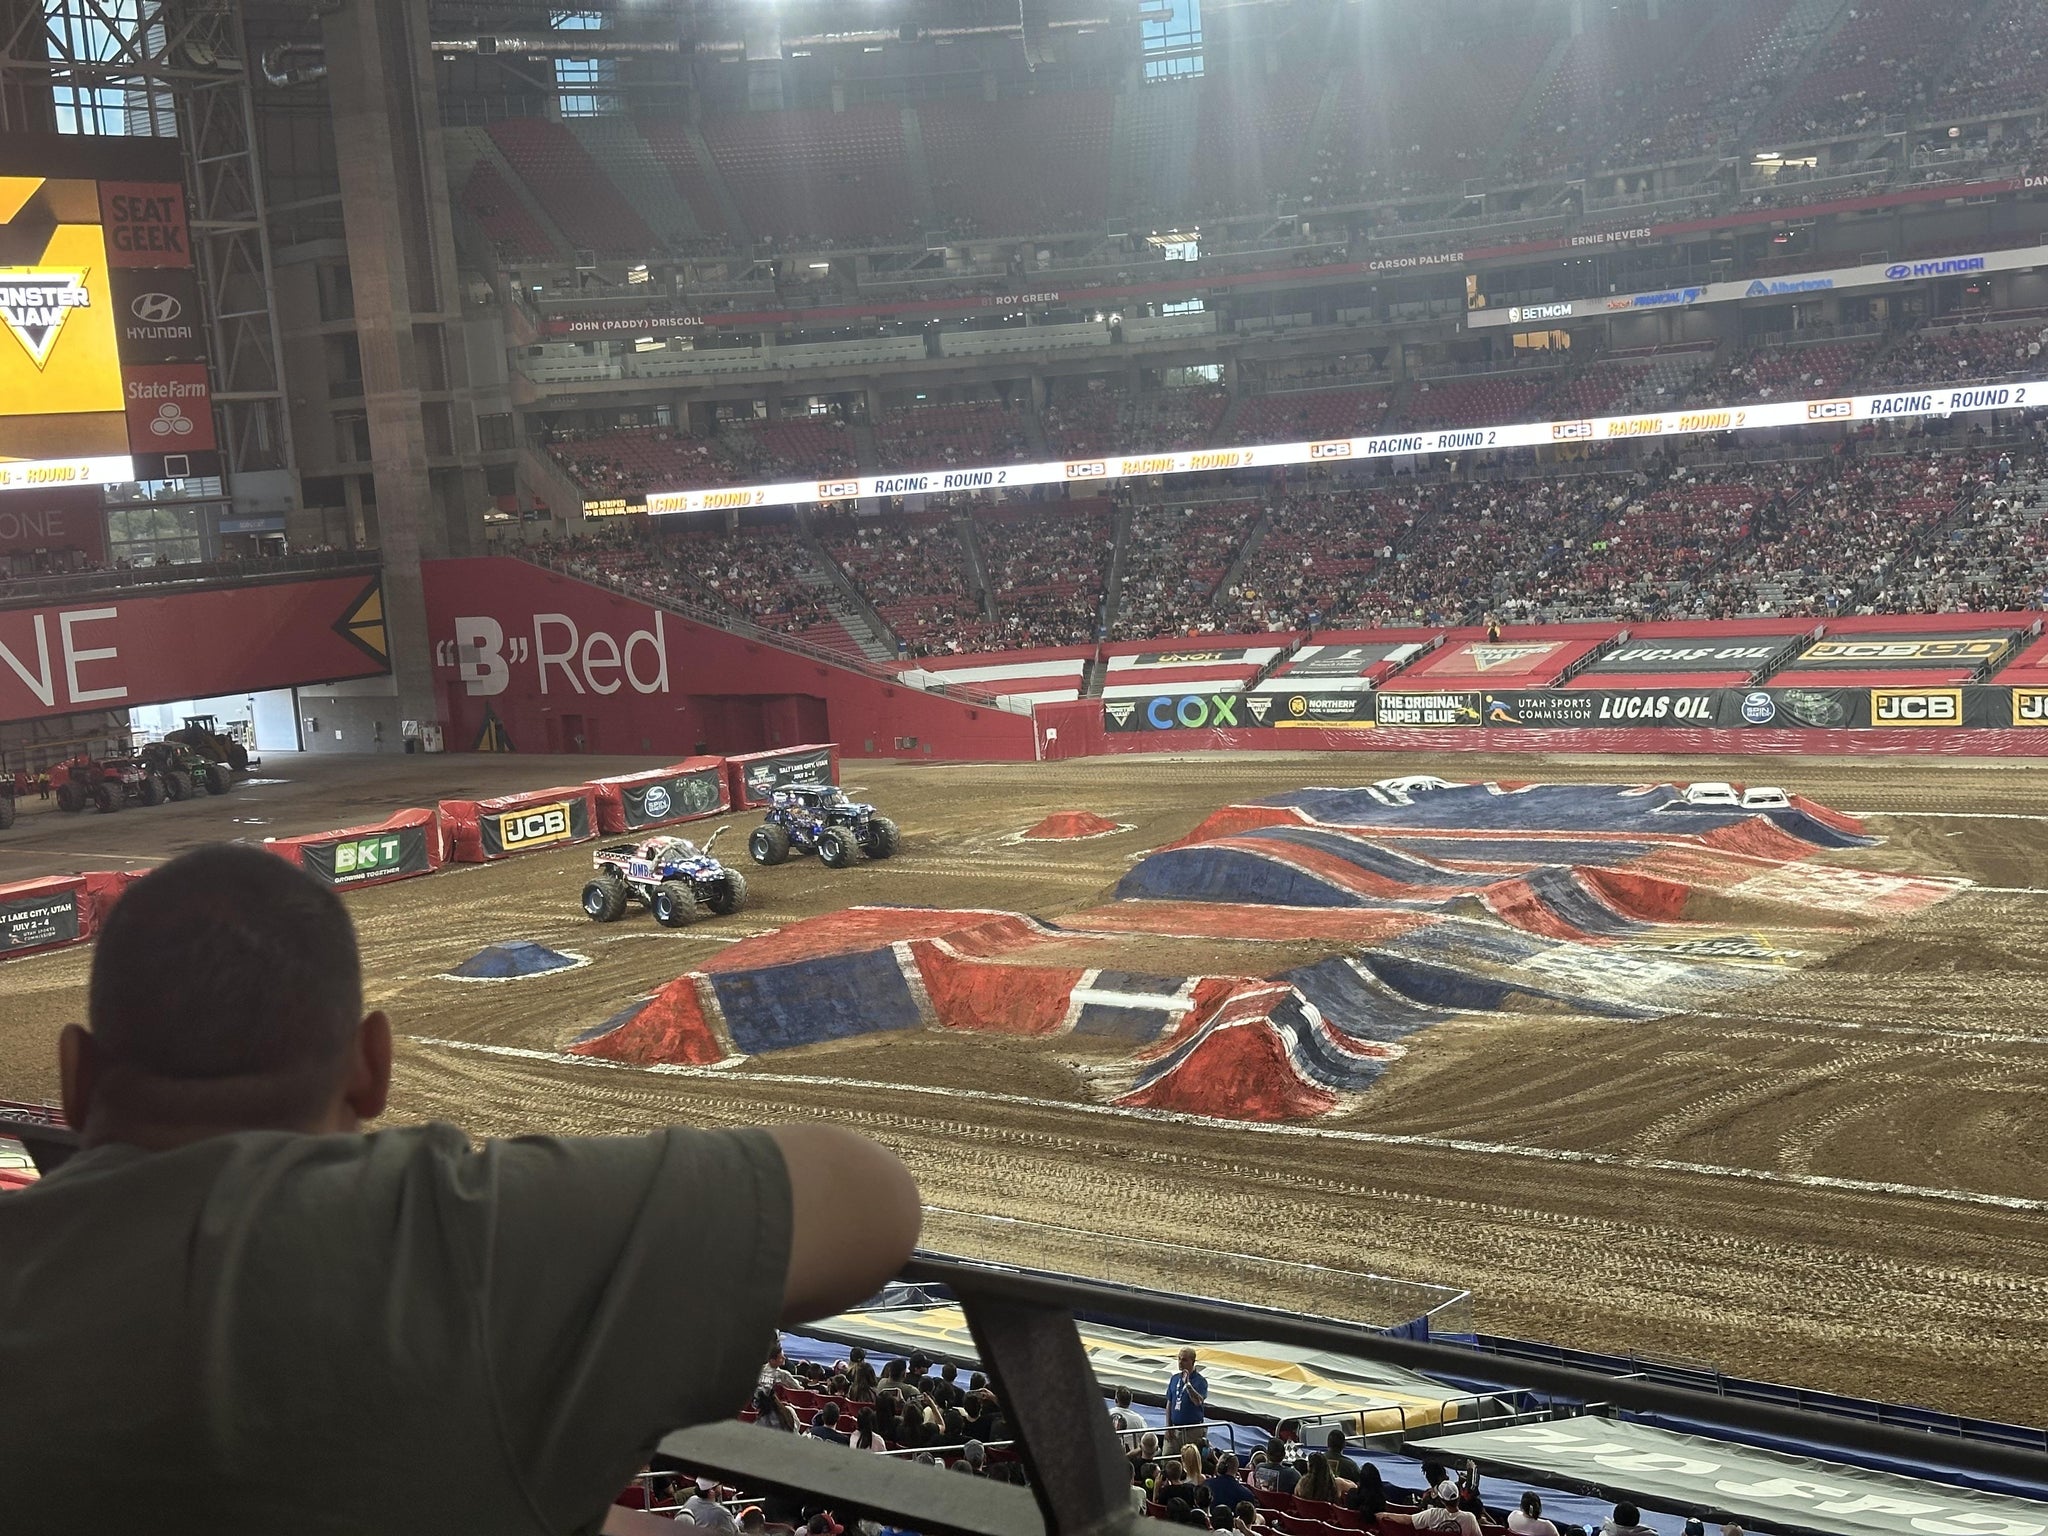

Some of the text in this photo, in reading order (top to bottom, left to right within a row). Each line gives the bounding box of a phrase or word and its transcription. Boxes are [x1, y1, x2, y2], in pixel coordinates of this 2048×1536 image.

[111, 195, 175, 222] SEAT
[112, 225, 184, 254] GEEK
[1571, 234, 1604, 246] ERNIE
[1606, 228, 1651, 242] NEVERS
[1369, 257, 1416, 270] CARSON
[1419, 252, 1463, 265] PALMER
[1913, 257, 1985, 276] HYUNDAI
[996, 295, 1019, 305] ROY
[1022, 292, 1059, 303] GREEN
[10, 307, 62, 326] JAM
[1522, 303, 1572, 321] BETMGM
[127, 326, 192, 340] HYUNDAI
[570, 317, 704, 331] JOHN (PADDY) DRISCOLL
[1809, 402, 1851, 418] JCB
[1871, 395, 1932, 415] RACING
[1950, 389, 2009, 409] ROUND
[2014, 388, 2026, 404] 2
[1553, 423, 1592, 439] JCB
[1608, 419, 1662, 437] RACING
[1679, 413, 1731, 432] ROUND
[1736, 412, 1746, 427] 2
[1311, 442, 1350, 458] JCB
[1368, 436, 1422, 454] RACING
[1438, 432, 1484, 452] ROUND
[1488, 431, 1497, 445] 2
[1067, 462, 1105, 478] JCB
[1122, 458, 1175, 475] RACING
[1190, 453, 1239, 470] ROUND
[1244, 452, 1253, 465] 2
[27, 467, 76, 483] ROUND
[80, 467, 90, 481] 2
[820, 482, 858, 498] JCB
[875, 476, 928, 493] RACING
[943, 472, 993, 488] ROUND
[997, 471, 1007, 484] 2
[703, 492, 752, 509] ROUND
[755, 491, 765, 505] 2
[533, 610, 669, 695] Red
[1601, 648, 1715, 661] LUCAS
[1811, 643, 1922, 657] JCB
[1309, 699, 1357, 709] NORTHERN
[1379, 695, 1462, 709] THE ORIGINAL
[1518, 698, 1591, 709] UTAH SPORTS
[1599, 696, 1669, 720] LUCAS
[1878, 696, 1955, 719] JCB
[1147, 695, 1238, 730] COX
[1379, 709, 1456, 723] SUPER GLUE
[1518, 709, 1592, 720] COMMISSION
[506, 810, 565, 842] JCB
[336, 840, 399, 868] BKT
[335, 867, 400, 884] GROWING TOGETHER
[8, 911, 29, 922] LAKE
[30, 907, 50, 918] CITY,
[50, 903, 72, 914] UTAH
[12, 923, 30, 932] JULY
[44, 918, 50, 926] 4
